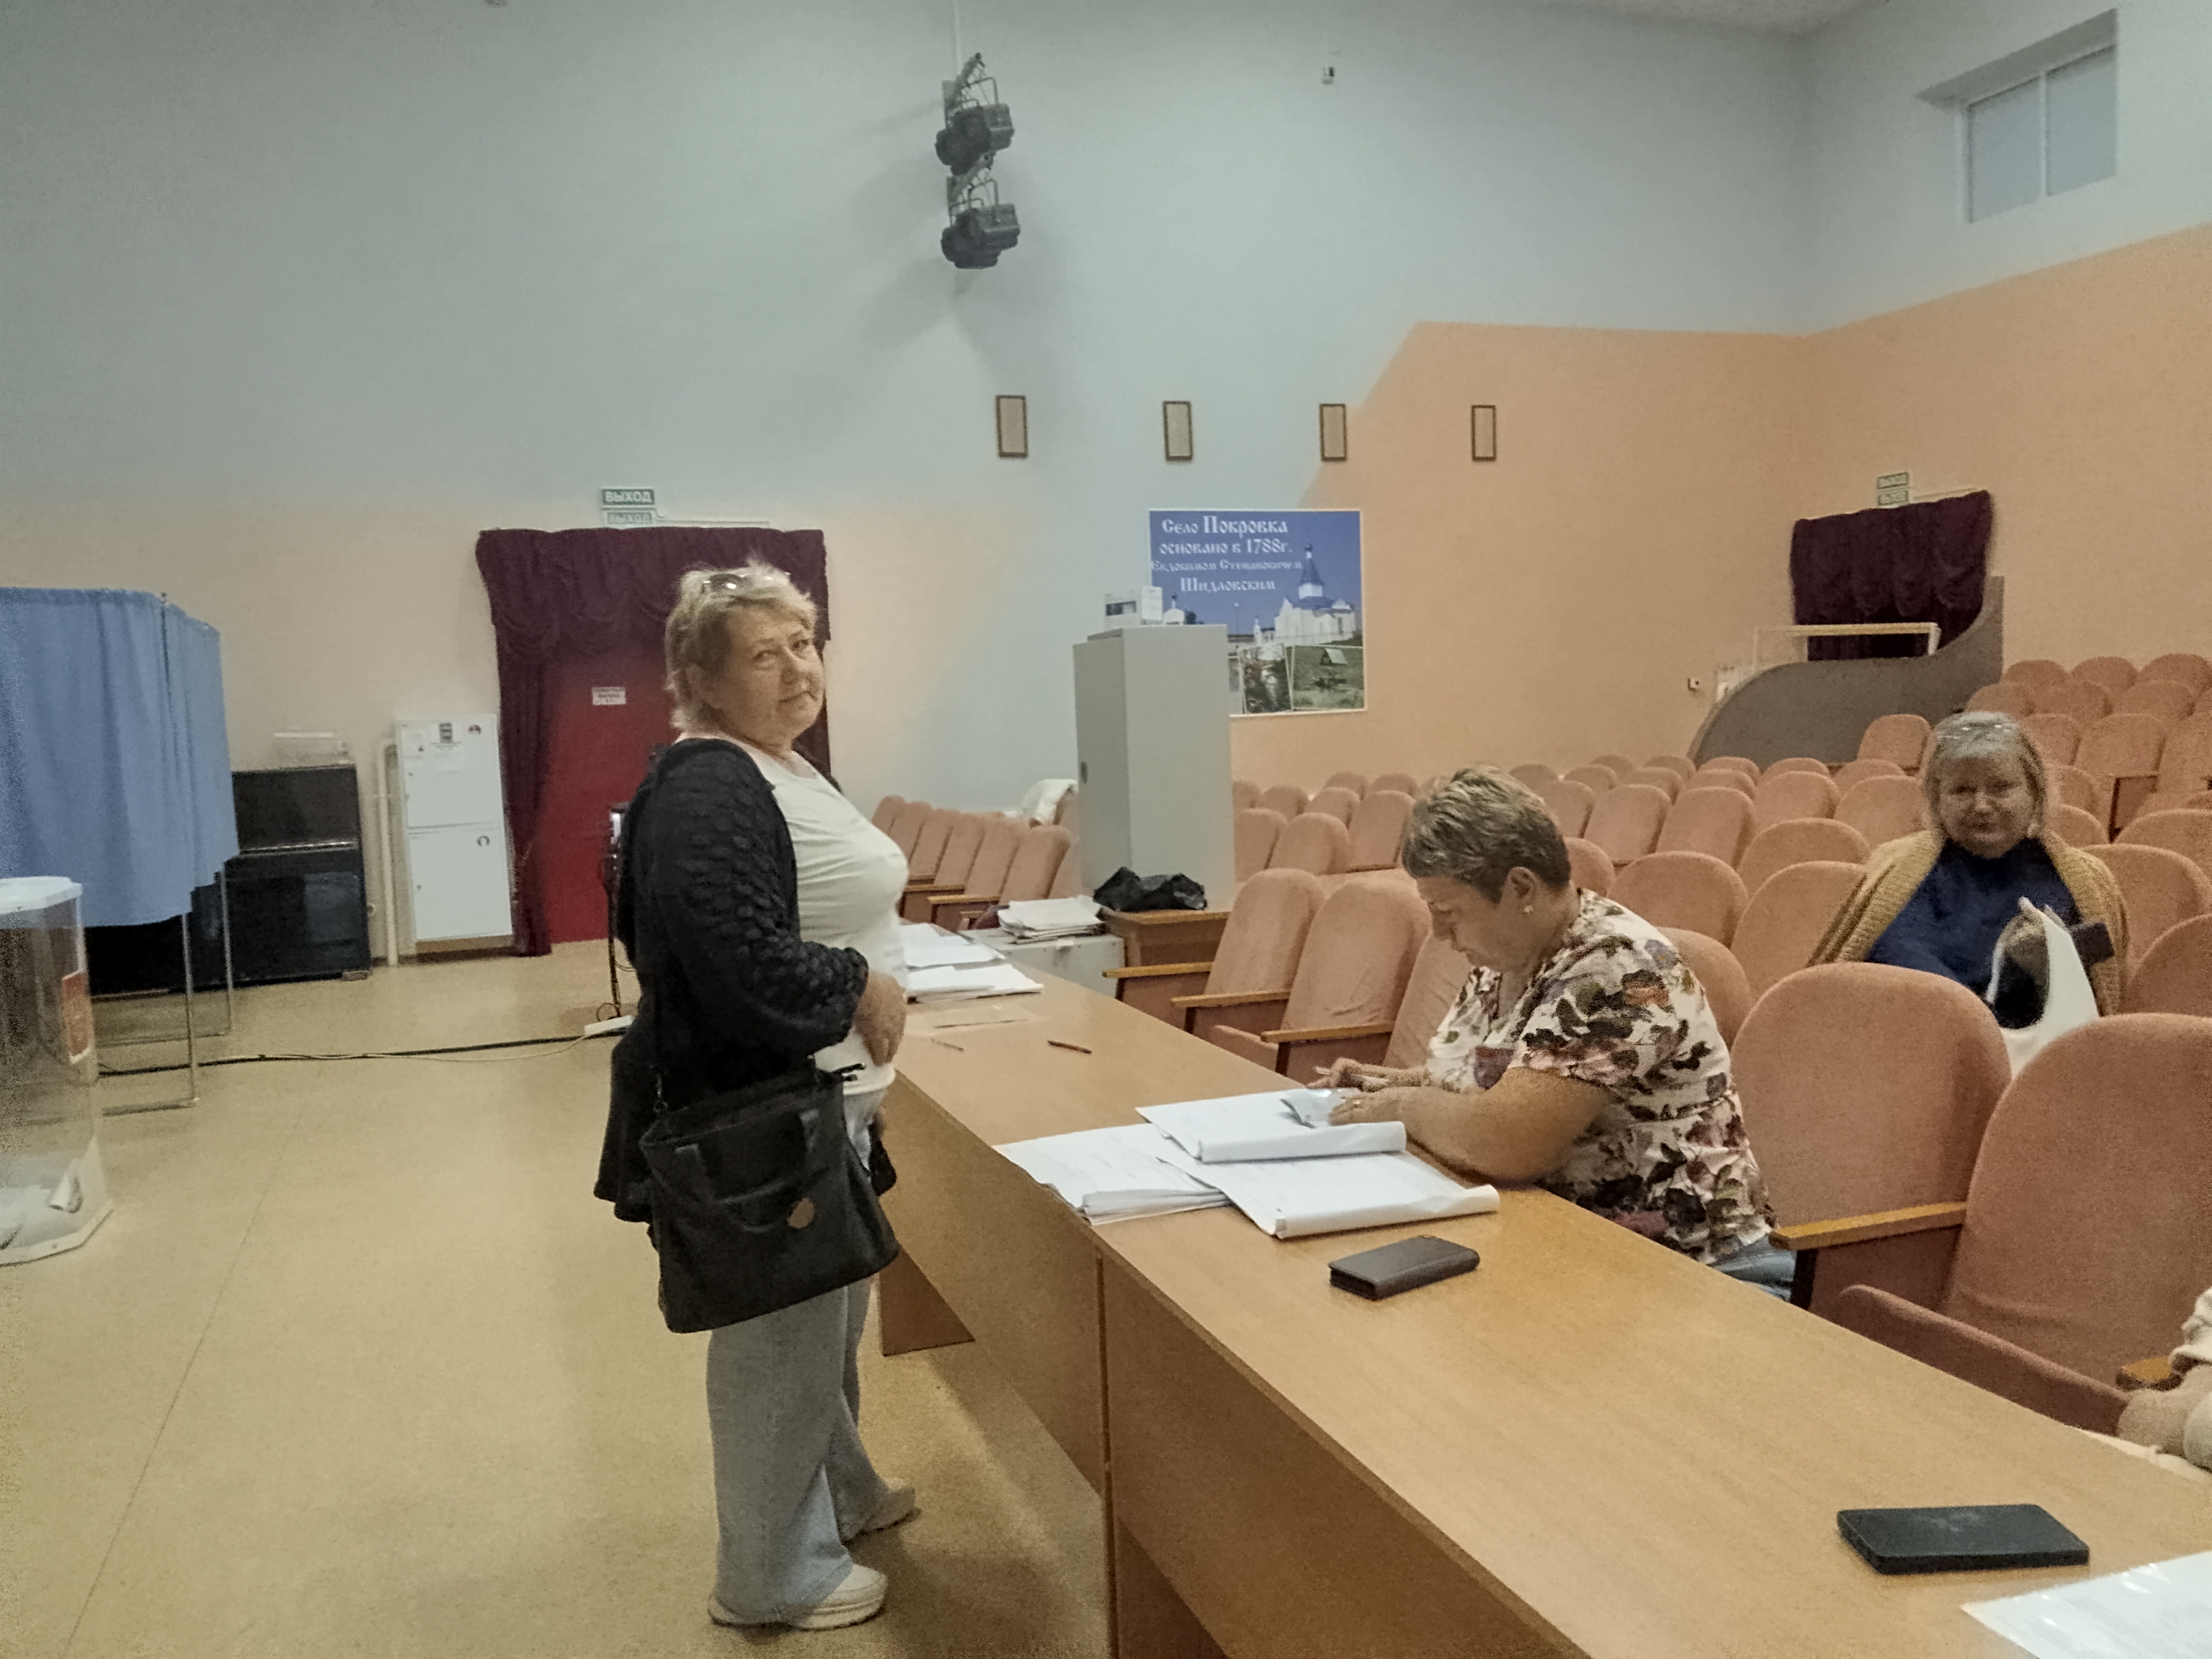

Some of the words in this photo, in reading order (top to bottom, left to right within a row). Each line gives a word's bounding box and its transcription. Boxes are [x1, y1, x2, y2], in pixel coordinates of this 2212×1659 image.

[605, 491, 652, 504] ВЫХОД
[1162, 519, 1199, 533] Село
[1203, 516, 1288, 539] Покровка
[1159, 543, 1229, 554] основано
[1232, 544, 1242, 553] в
[1181, 577, 1275, 592] Шидловским
